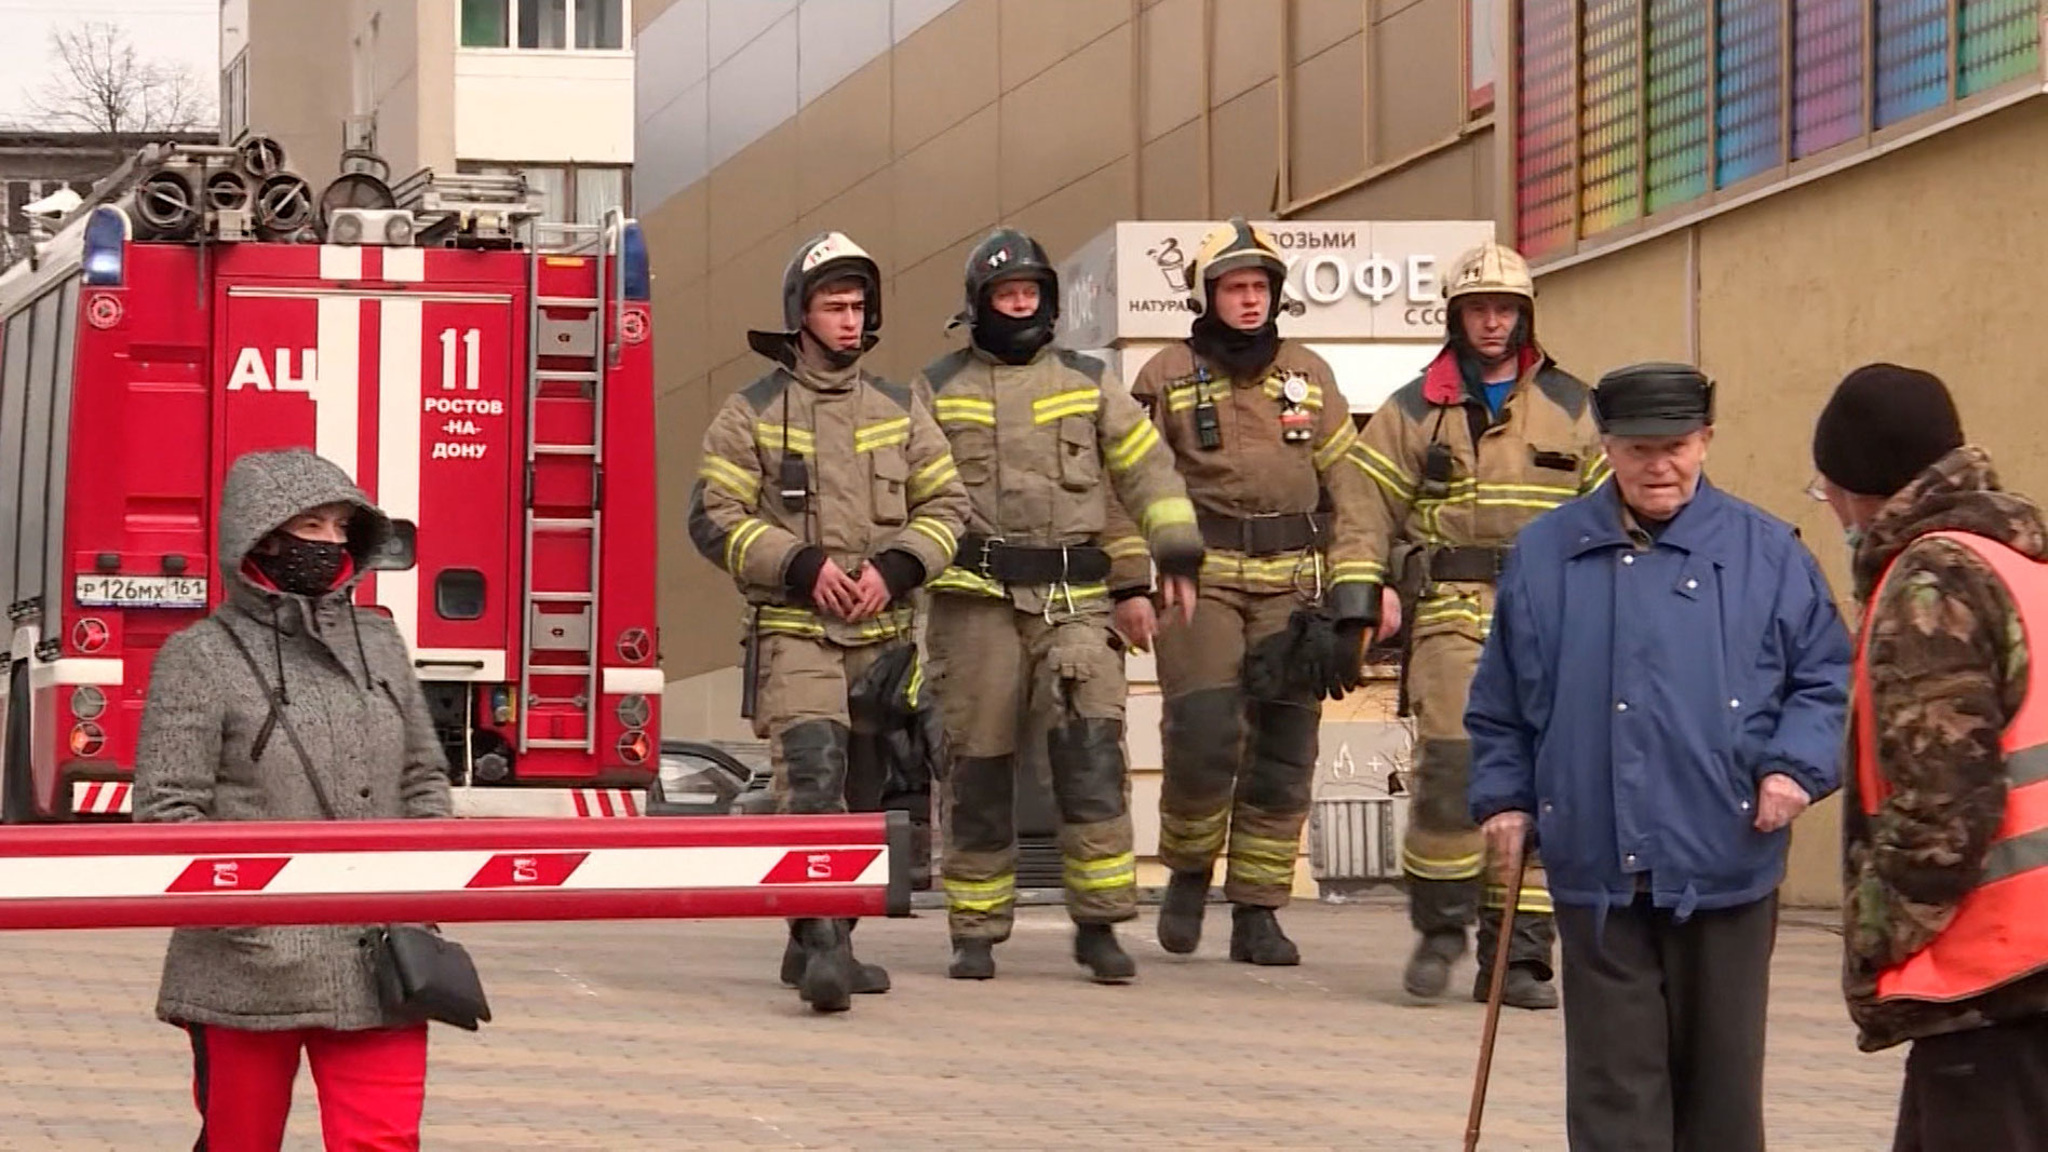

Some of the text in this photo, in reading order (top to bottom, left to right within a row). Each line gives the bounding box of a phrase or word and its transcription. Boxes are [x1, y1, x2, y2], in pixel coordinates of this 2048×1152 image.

[1129, 300, 1191, 312] НАТУРА
[439, 328, 480, 390] 11
[226, 347, 318, 400] АЦ
[424, 397, 504, 415] РОСТОВ
[441, 420, 482, 435] -НА-
[431, 442, 487, 459] ДОНУ
